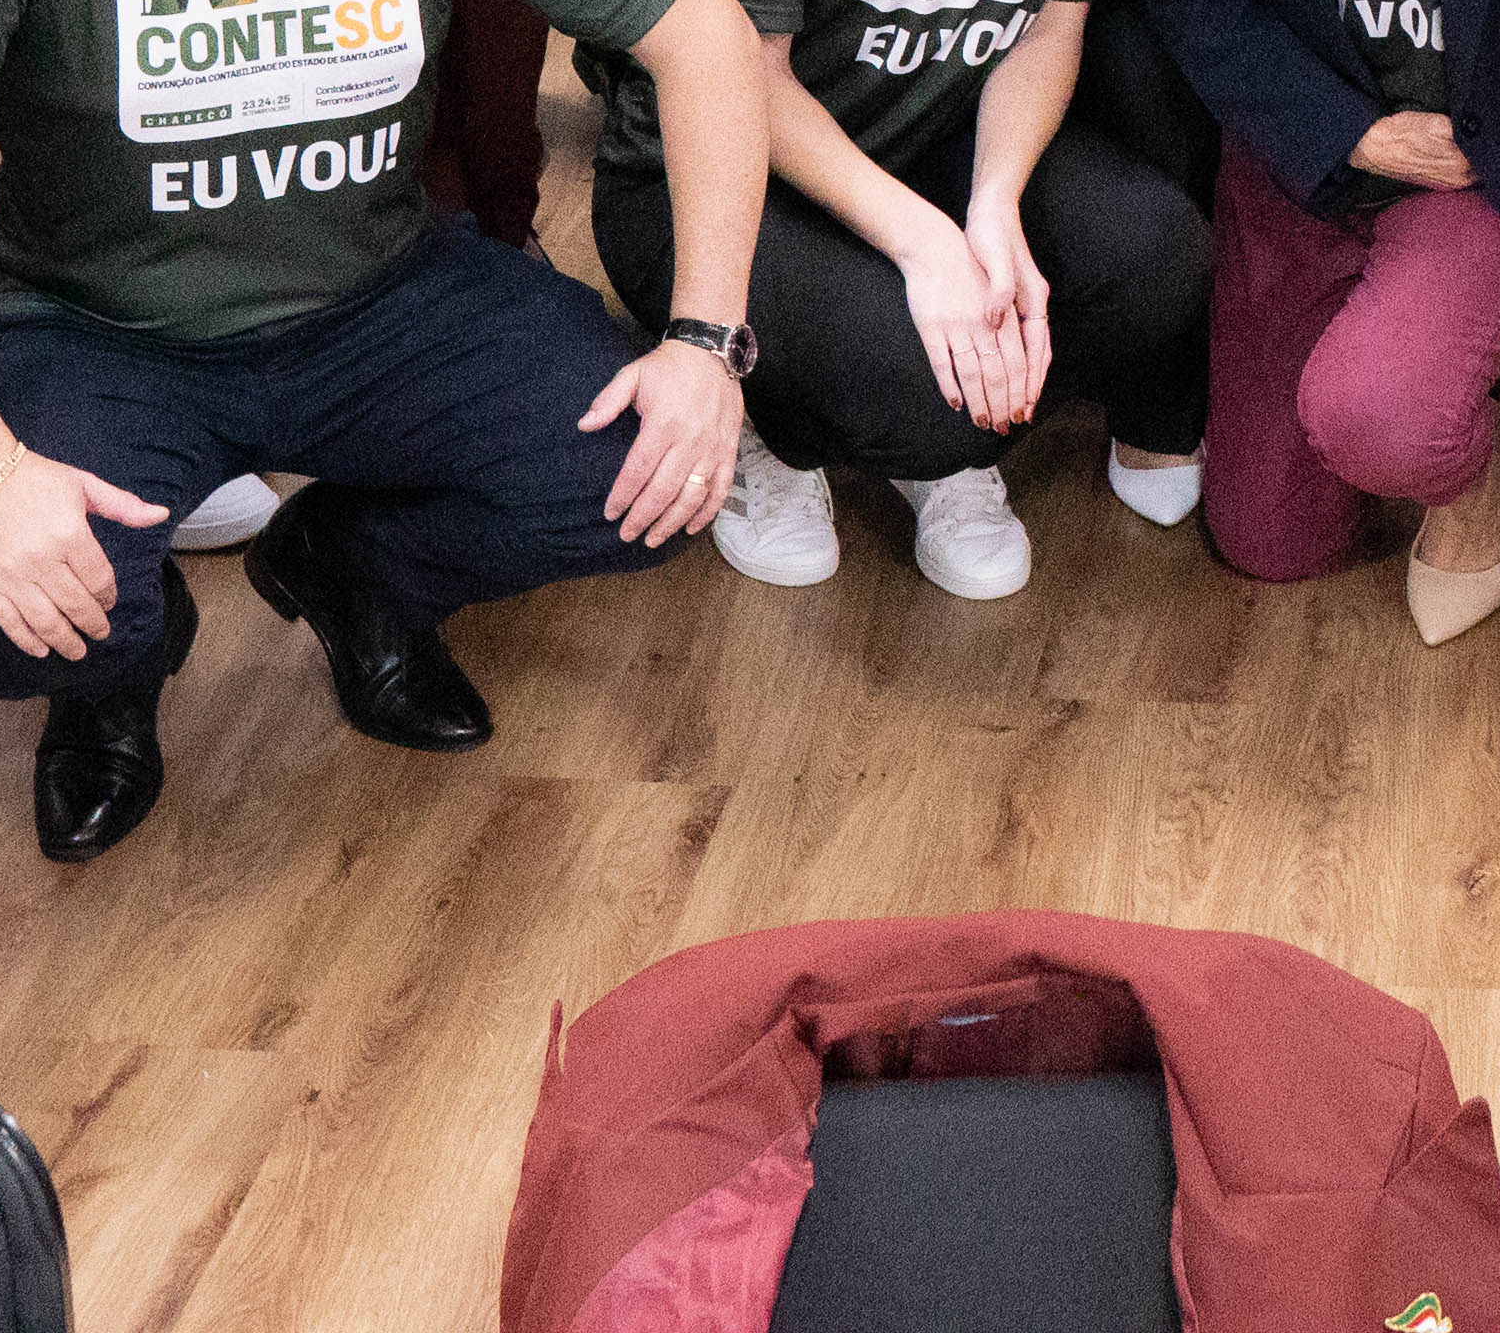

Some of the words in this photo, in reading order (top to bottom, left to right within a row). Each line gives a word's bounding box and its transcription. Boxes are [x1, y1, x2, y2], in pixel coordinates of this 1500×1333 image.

[138, 78, 194, 90] CONVENÇÃO
[195, 76, 207, 85] DA
[208, 64, 277, 82] CONTABILIDADE
[278, 60, 291, 70] DO
[292, 56, 326, 68] ESTADO
[327, 55, 338, 65] DE
[339, 52, 368, 63] SANTA
[368, 42, 408, 59] CATARINA
[855, 24, 929, 75] EU
[146, 107, 228, 126] CHAPECÓ
[242, 100, 256, 110] 23
[258, 97, 272, 108] 24
[276, 94, 291, 104] 25
[151, 156, 237, 212] EU
[252, 122, 401, 200] VOU!
